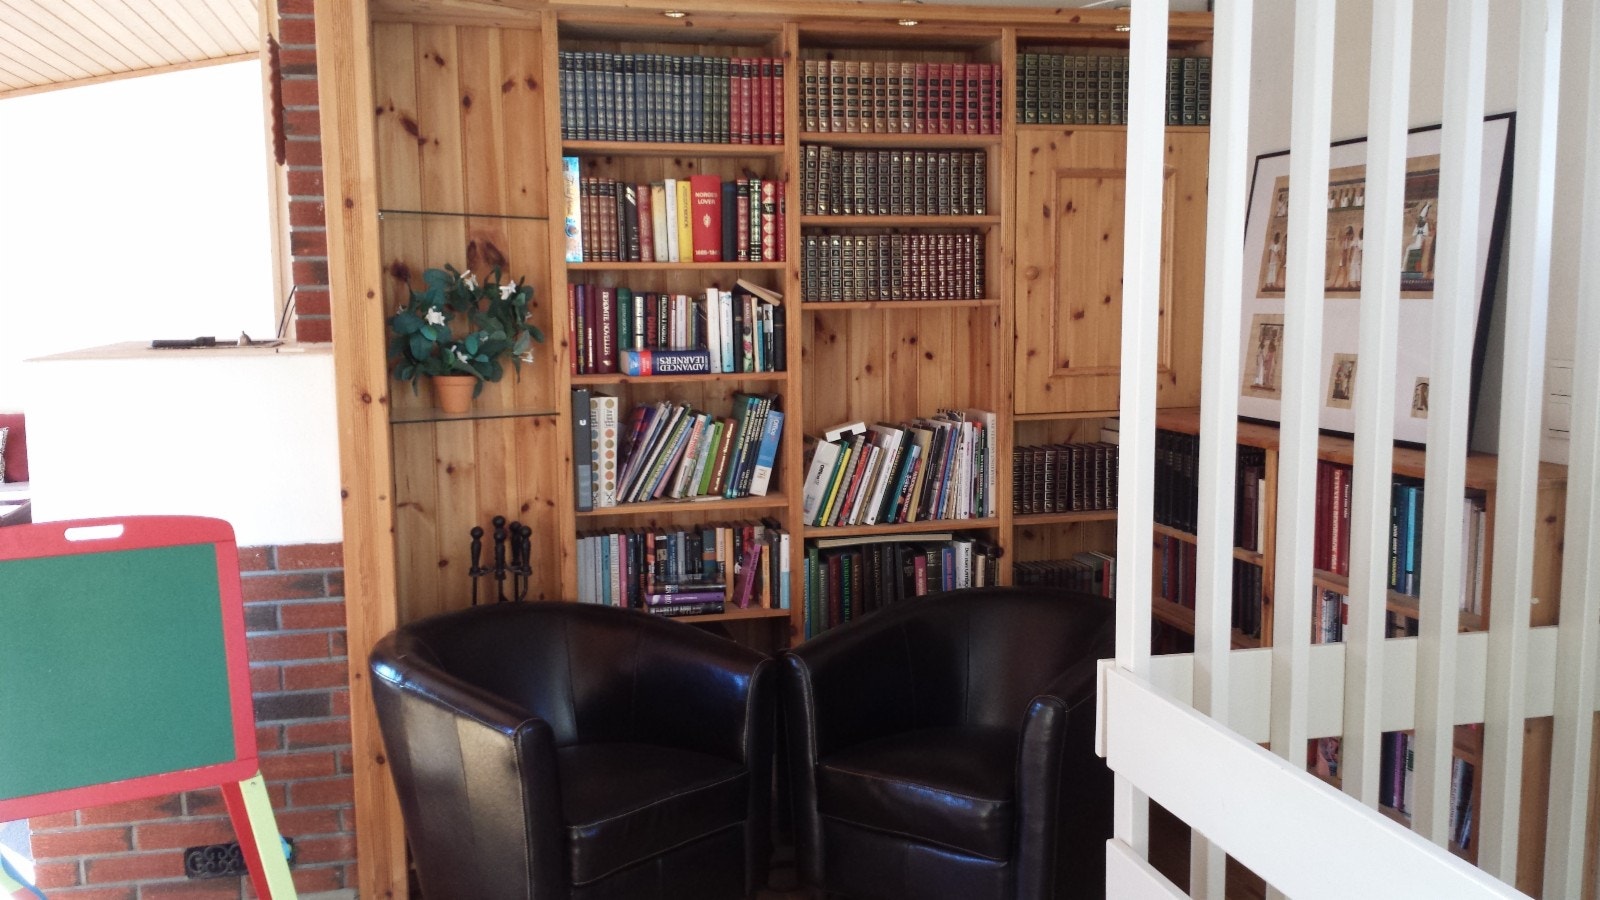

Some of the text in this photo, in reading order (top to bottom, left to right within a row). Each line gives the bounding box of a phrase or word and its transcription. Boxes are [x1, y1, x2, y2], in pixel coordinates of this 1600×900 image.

[602, 291, 610, 356] BERØMTE NOVELLER
[659, 356, 704, 364] LEARNER'S
[660, 363, 705, 372] ADVANCED
[770, 419, 780, 436] Office
[816, 464, 825, 480] Office
